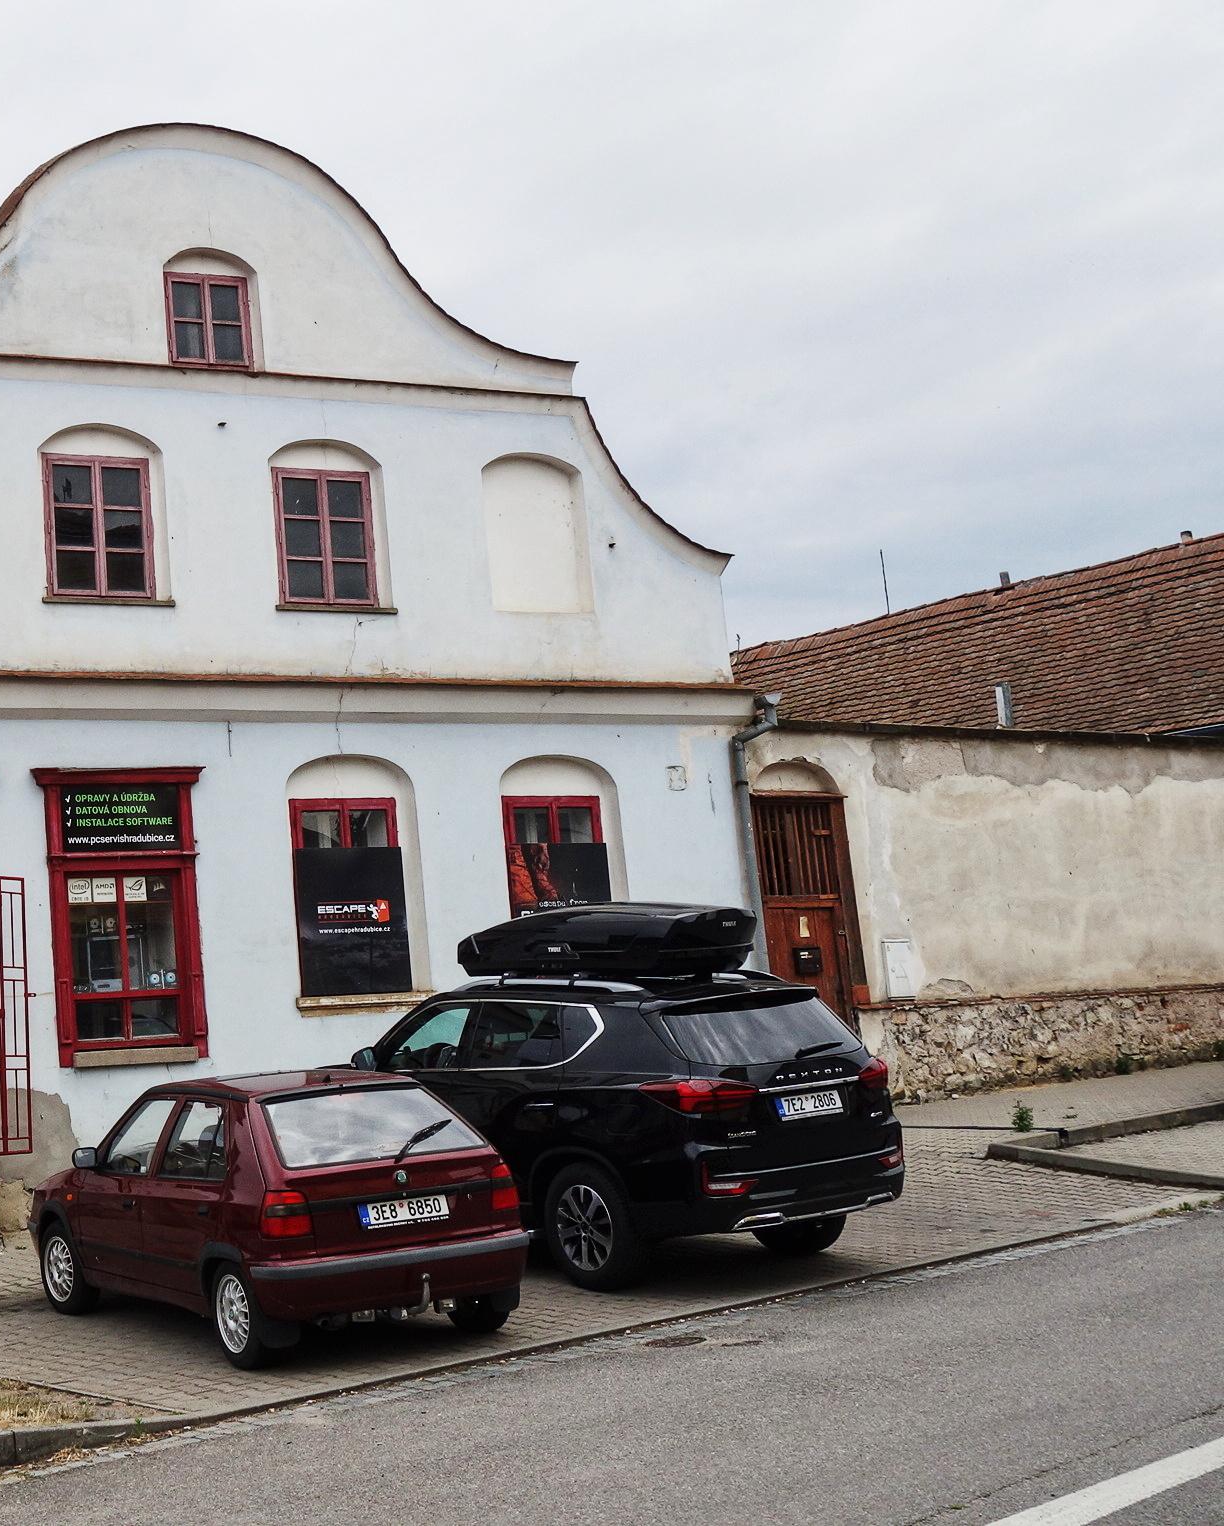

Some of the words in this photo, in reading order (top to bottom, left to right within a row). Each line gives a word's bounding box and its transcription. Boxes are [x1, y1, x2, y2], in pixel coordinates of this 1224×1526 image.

[75, 793, 110, 802] OPRAVY
[112, 794, 119, 802] A
[120, 792, 156, 802] ÚDRŽBA
[76, 804, 110, 815] DATOVÁ
[111, 805, 148, 814] OBNOVA
[76, 818, 125, 827] INSTALACE
[126, 817, 173, 826] SOFTWARE
[67, 833, 175, 846] www.pcservishradubice.cz
[317, 904, 367, 914] ESCAPE
[318, 926, 391, 935] www.escapehradubice.cz
[784, 1097, 805, 1113] 7E2
[810, 1092, 837, 1109] 2806
[371, 1203, 398, 1221] 3E8
[407, 1197, 442, 1217] 6850
